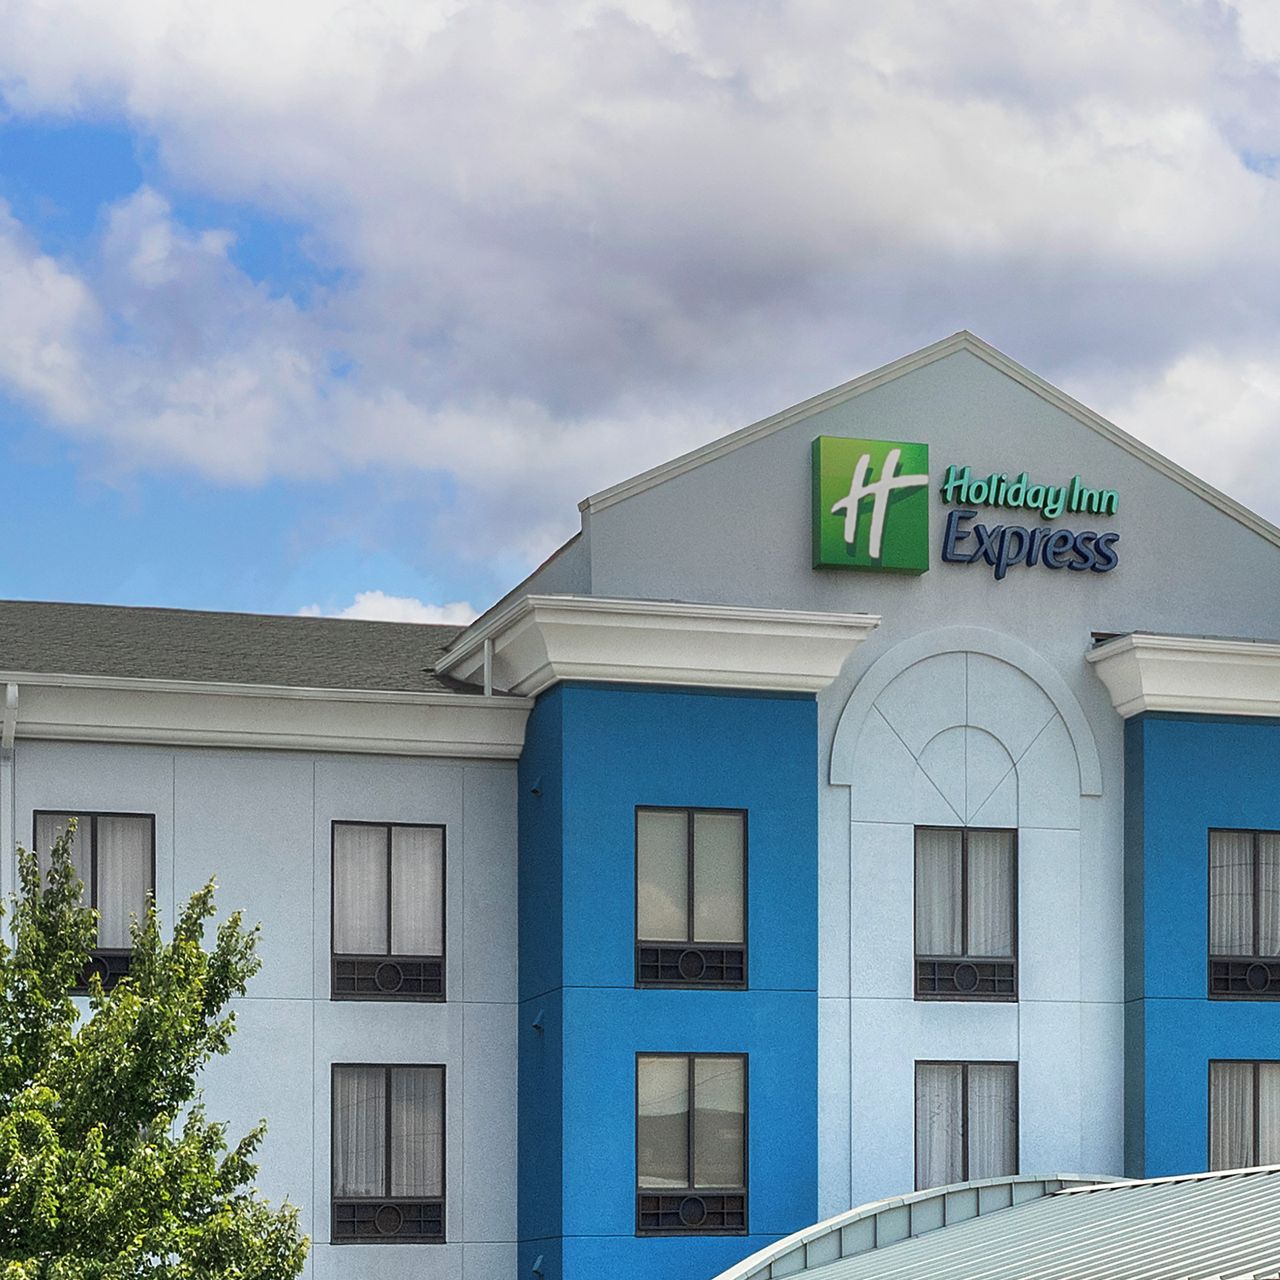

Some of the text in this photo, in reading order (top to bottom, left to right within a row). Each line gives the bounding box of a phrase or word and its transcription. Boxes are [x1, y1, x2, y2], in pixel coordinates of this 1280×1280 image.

[941, 465, 1119, 520] Holiday Inn
[942, 510, 1120, 580] Express
